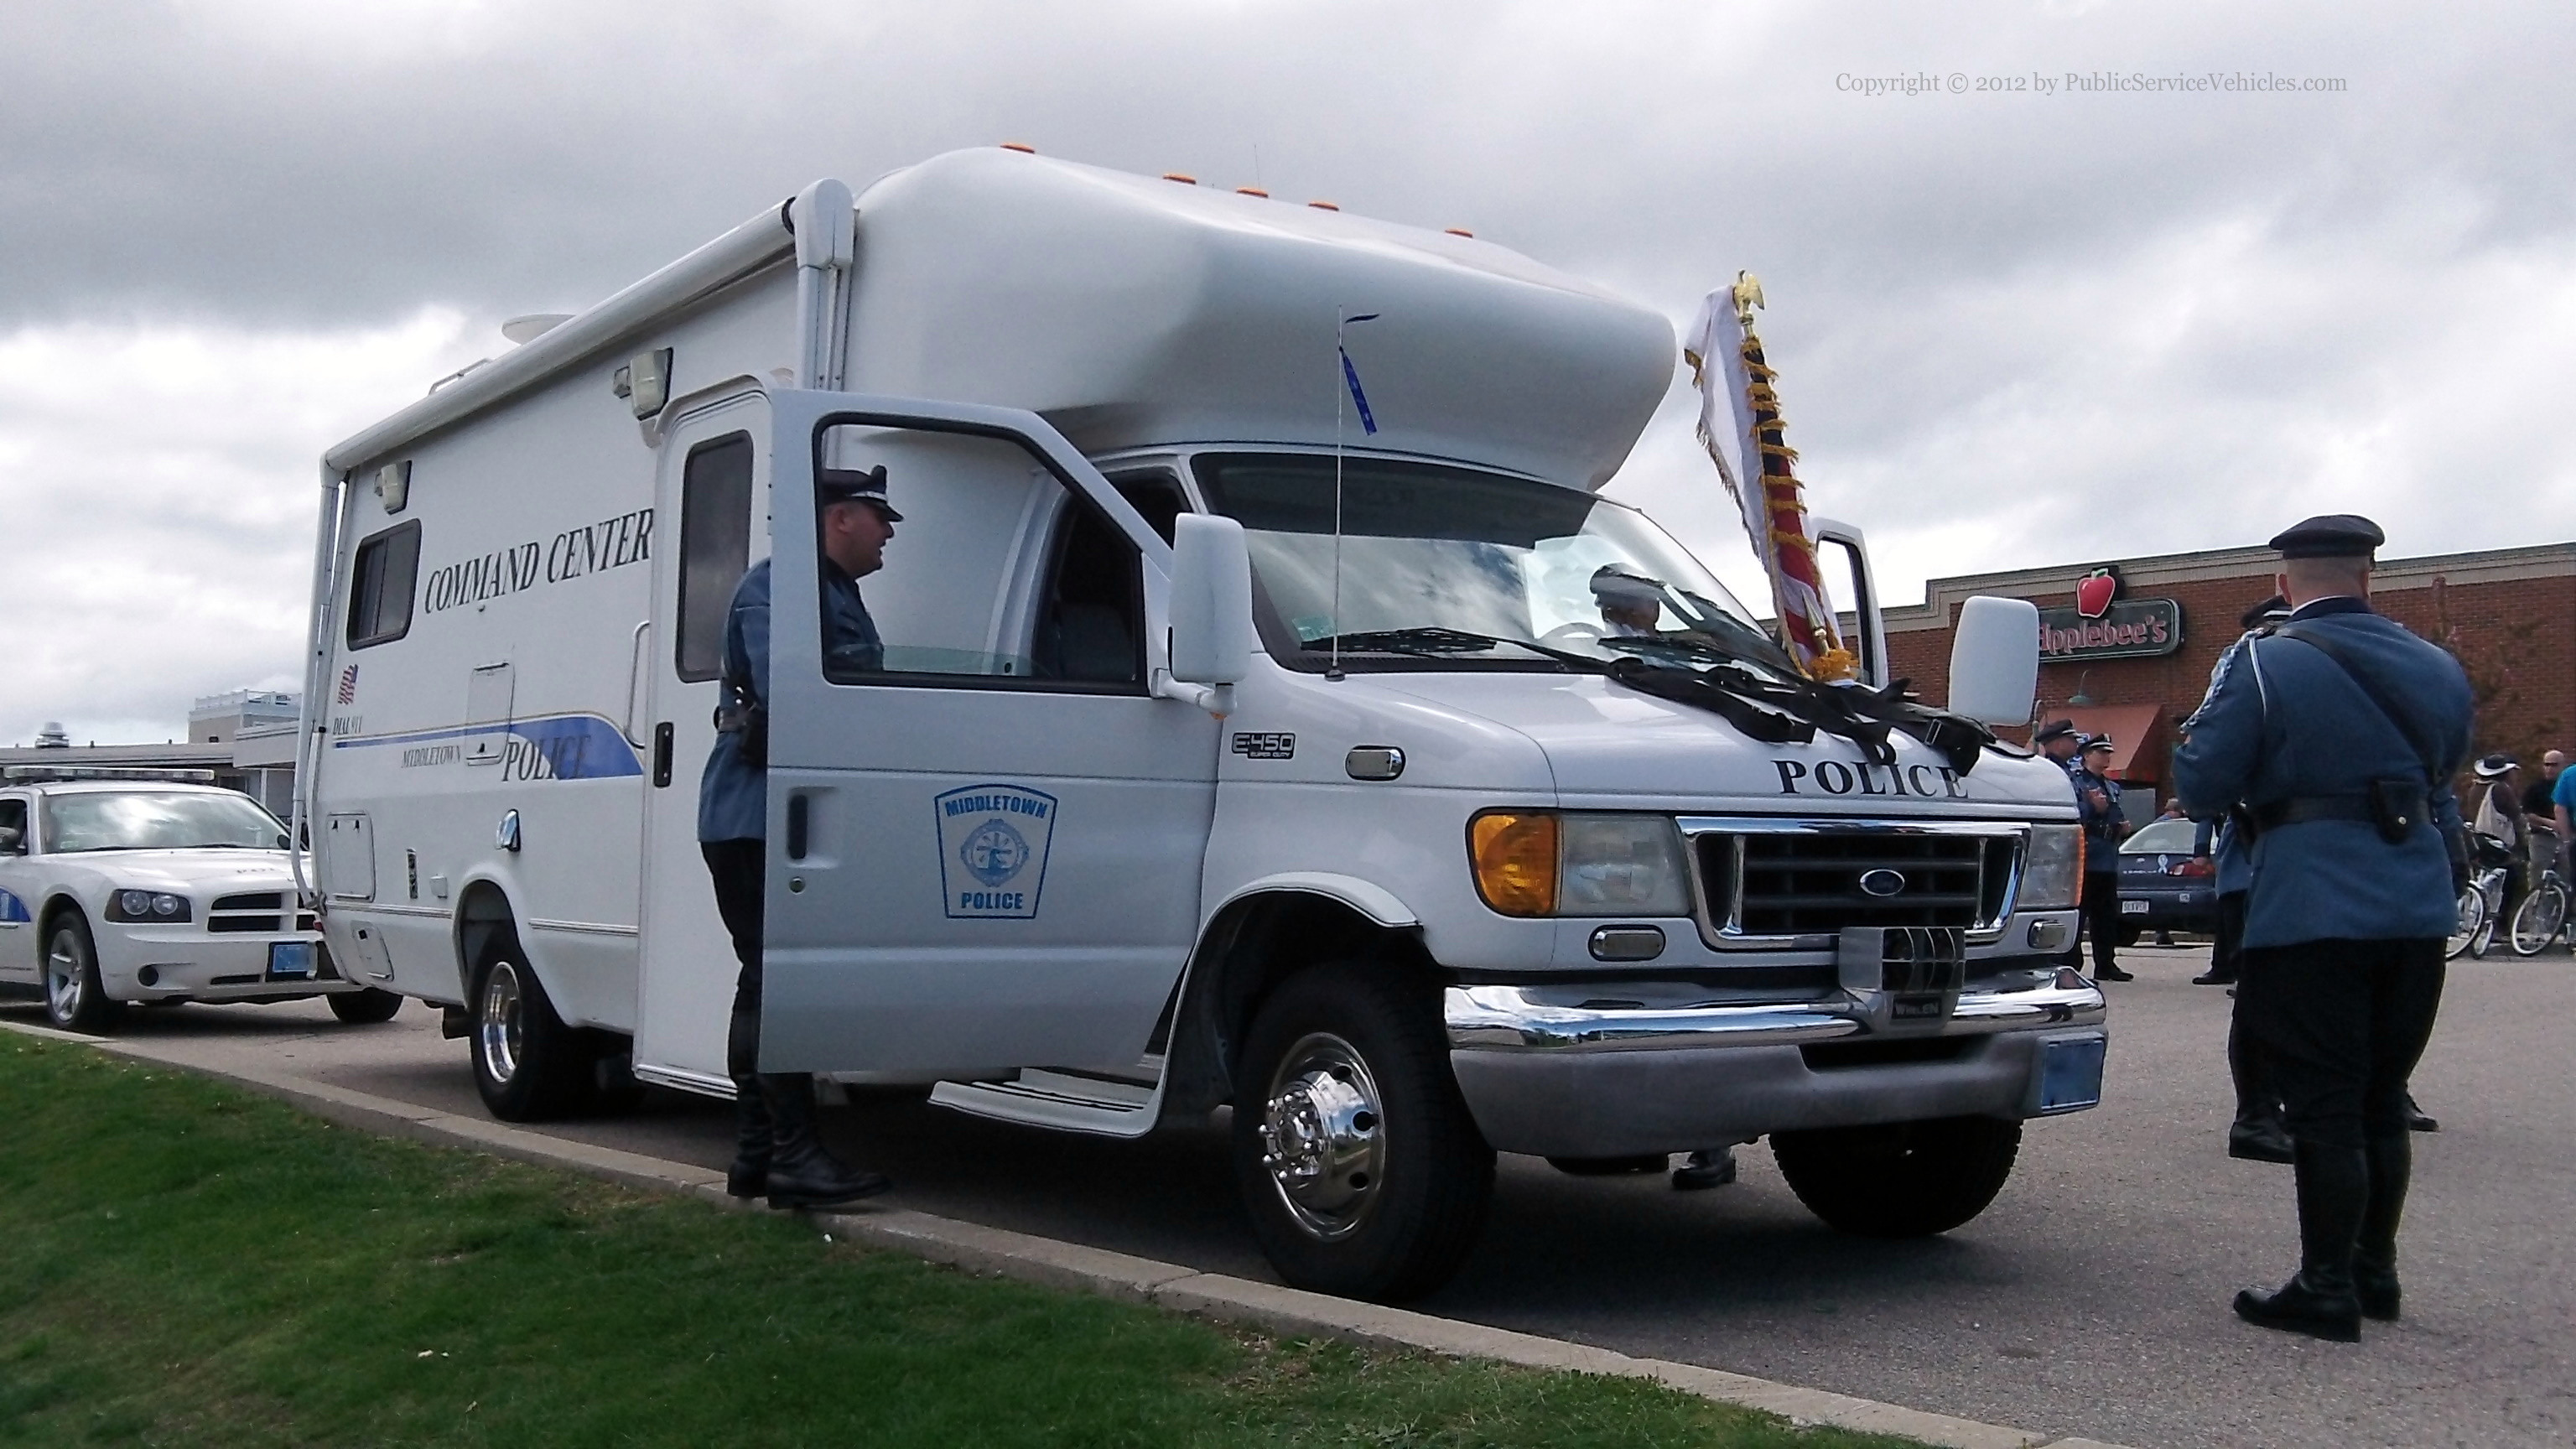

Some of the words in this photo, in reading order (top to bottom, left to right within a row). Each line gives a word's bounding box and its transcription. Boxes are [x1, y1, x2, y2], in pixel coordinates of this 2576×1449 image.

[424, 542, 540, 614] COMMAND
[548, 507, 654, 584] CENTER
[401, 745, 460, 768] MIDDLETOWN
[501, 734, 591, 782] POLICE
[1770, 760, 1969, 798] POLICE
[944, 795, 1048, 818] MIDDLETOWN
[960, 892, 1023, 909] POLICE
